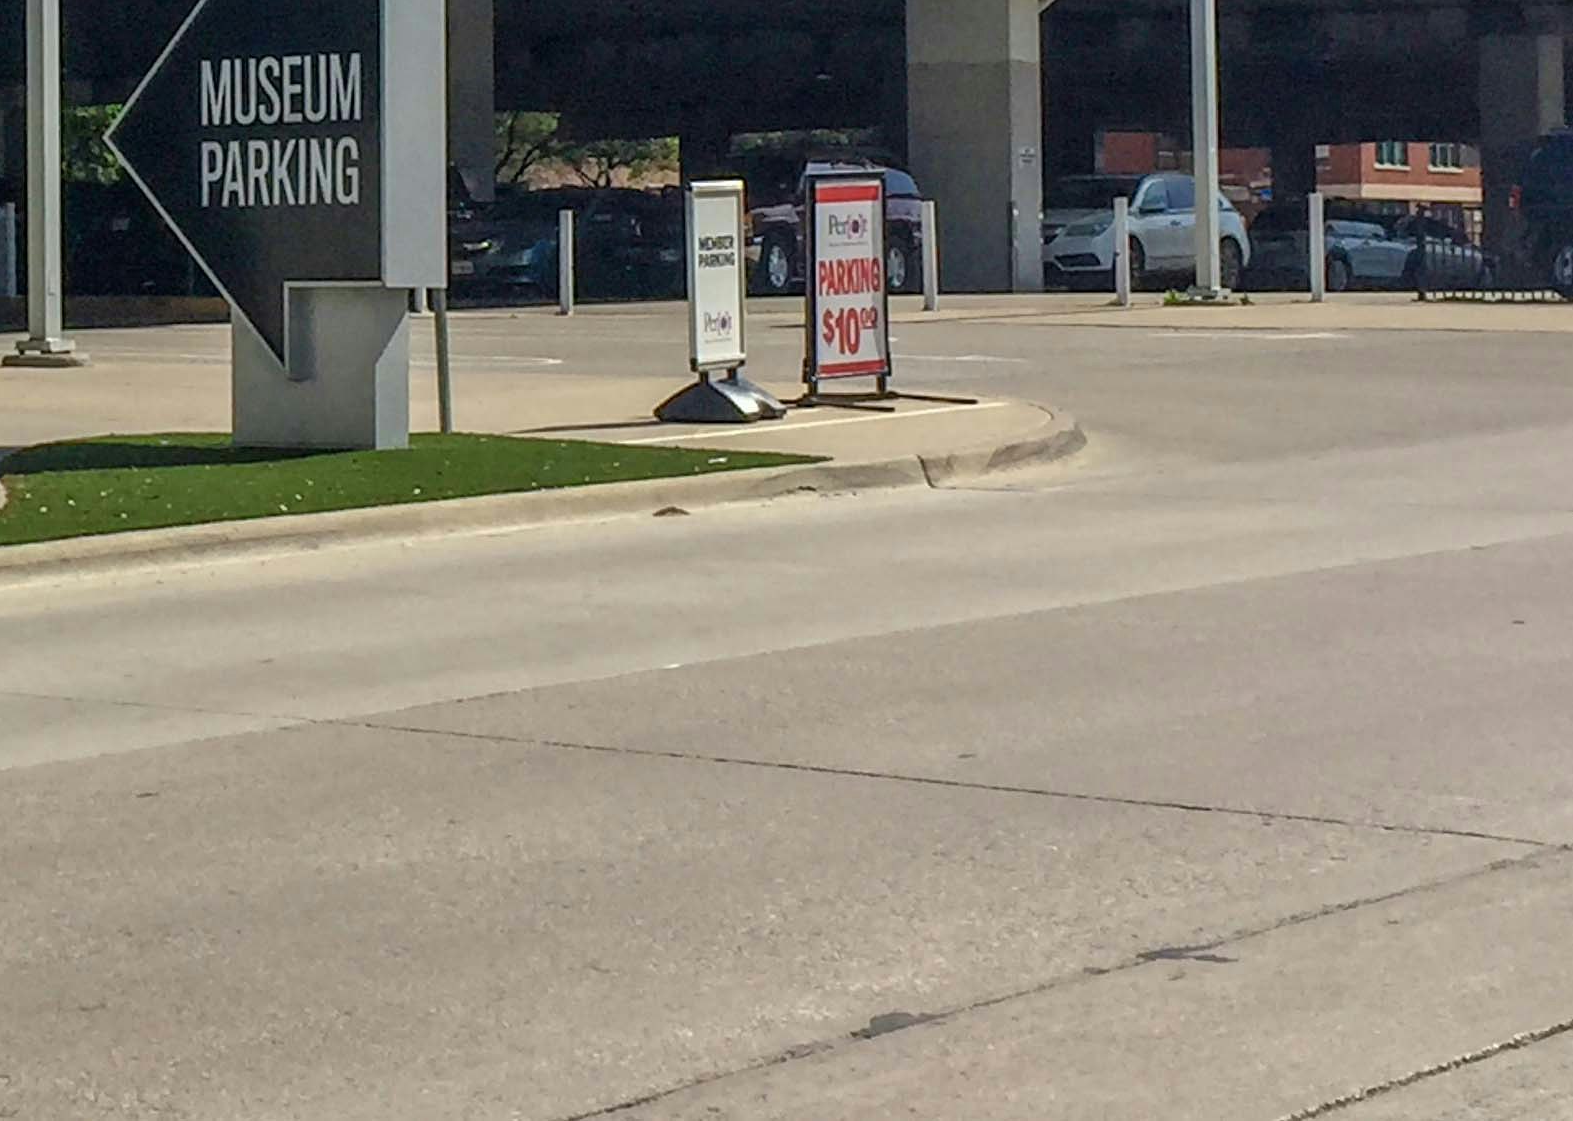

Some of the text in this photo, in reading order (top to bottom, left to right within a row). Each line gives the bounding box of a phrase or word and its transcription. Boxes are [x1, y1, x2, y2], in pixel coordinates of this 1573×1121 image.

[200, 52, 361, 126] MUSEUM
[200, 136, 360, 207] PARKING
[699, 235, 733, 251] MEMBER
[699, 252, 735, 268] PARKING
[819, 258, 881, 296] PARKING
